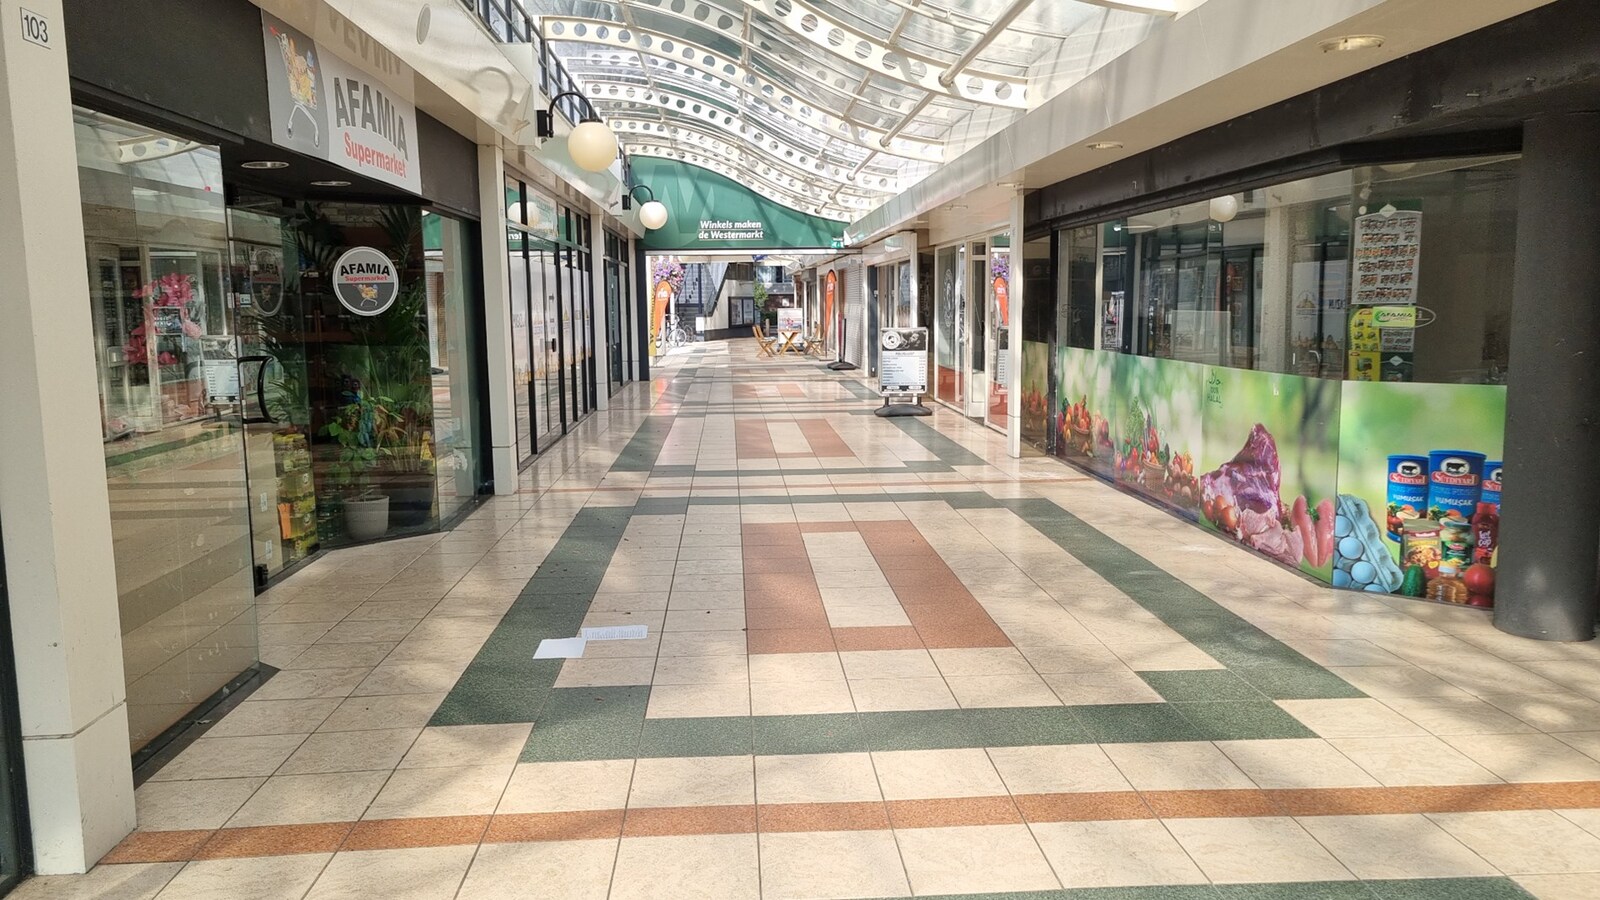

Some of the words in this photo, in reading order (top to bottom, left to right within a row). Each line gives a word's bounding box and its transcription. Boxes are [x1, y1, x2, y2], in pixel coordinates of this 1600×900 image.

[24, 14, 48, 43] 103
[333, 77, 408, 161] AFAMIA
[344, 132, 406, 178] Supermarket
[700, 221, 732, 229] Winkels
[734, 221, 762, 229] maken
[698, 231, 707, 239] de
[710, 230, 764, 239] Westermarkt
[340, 263, 391, 276] AFAMIA
[345, 274, 388, 282] Supermarket
